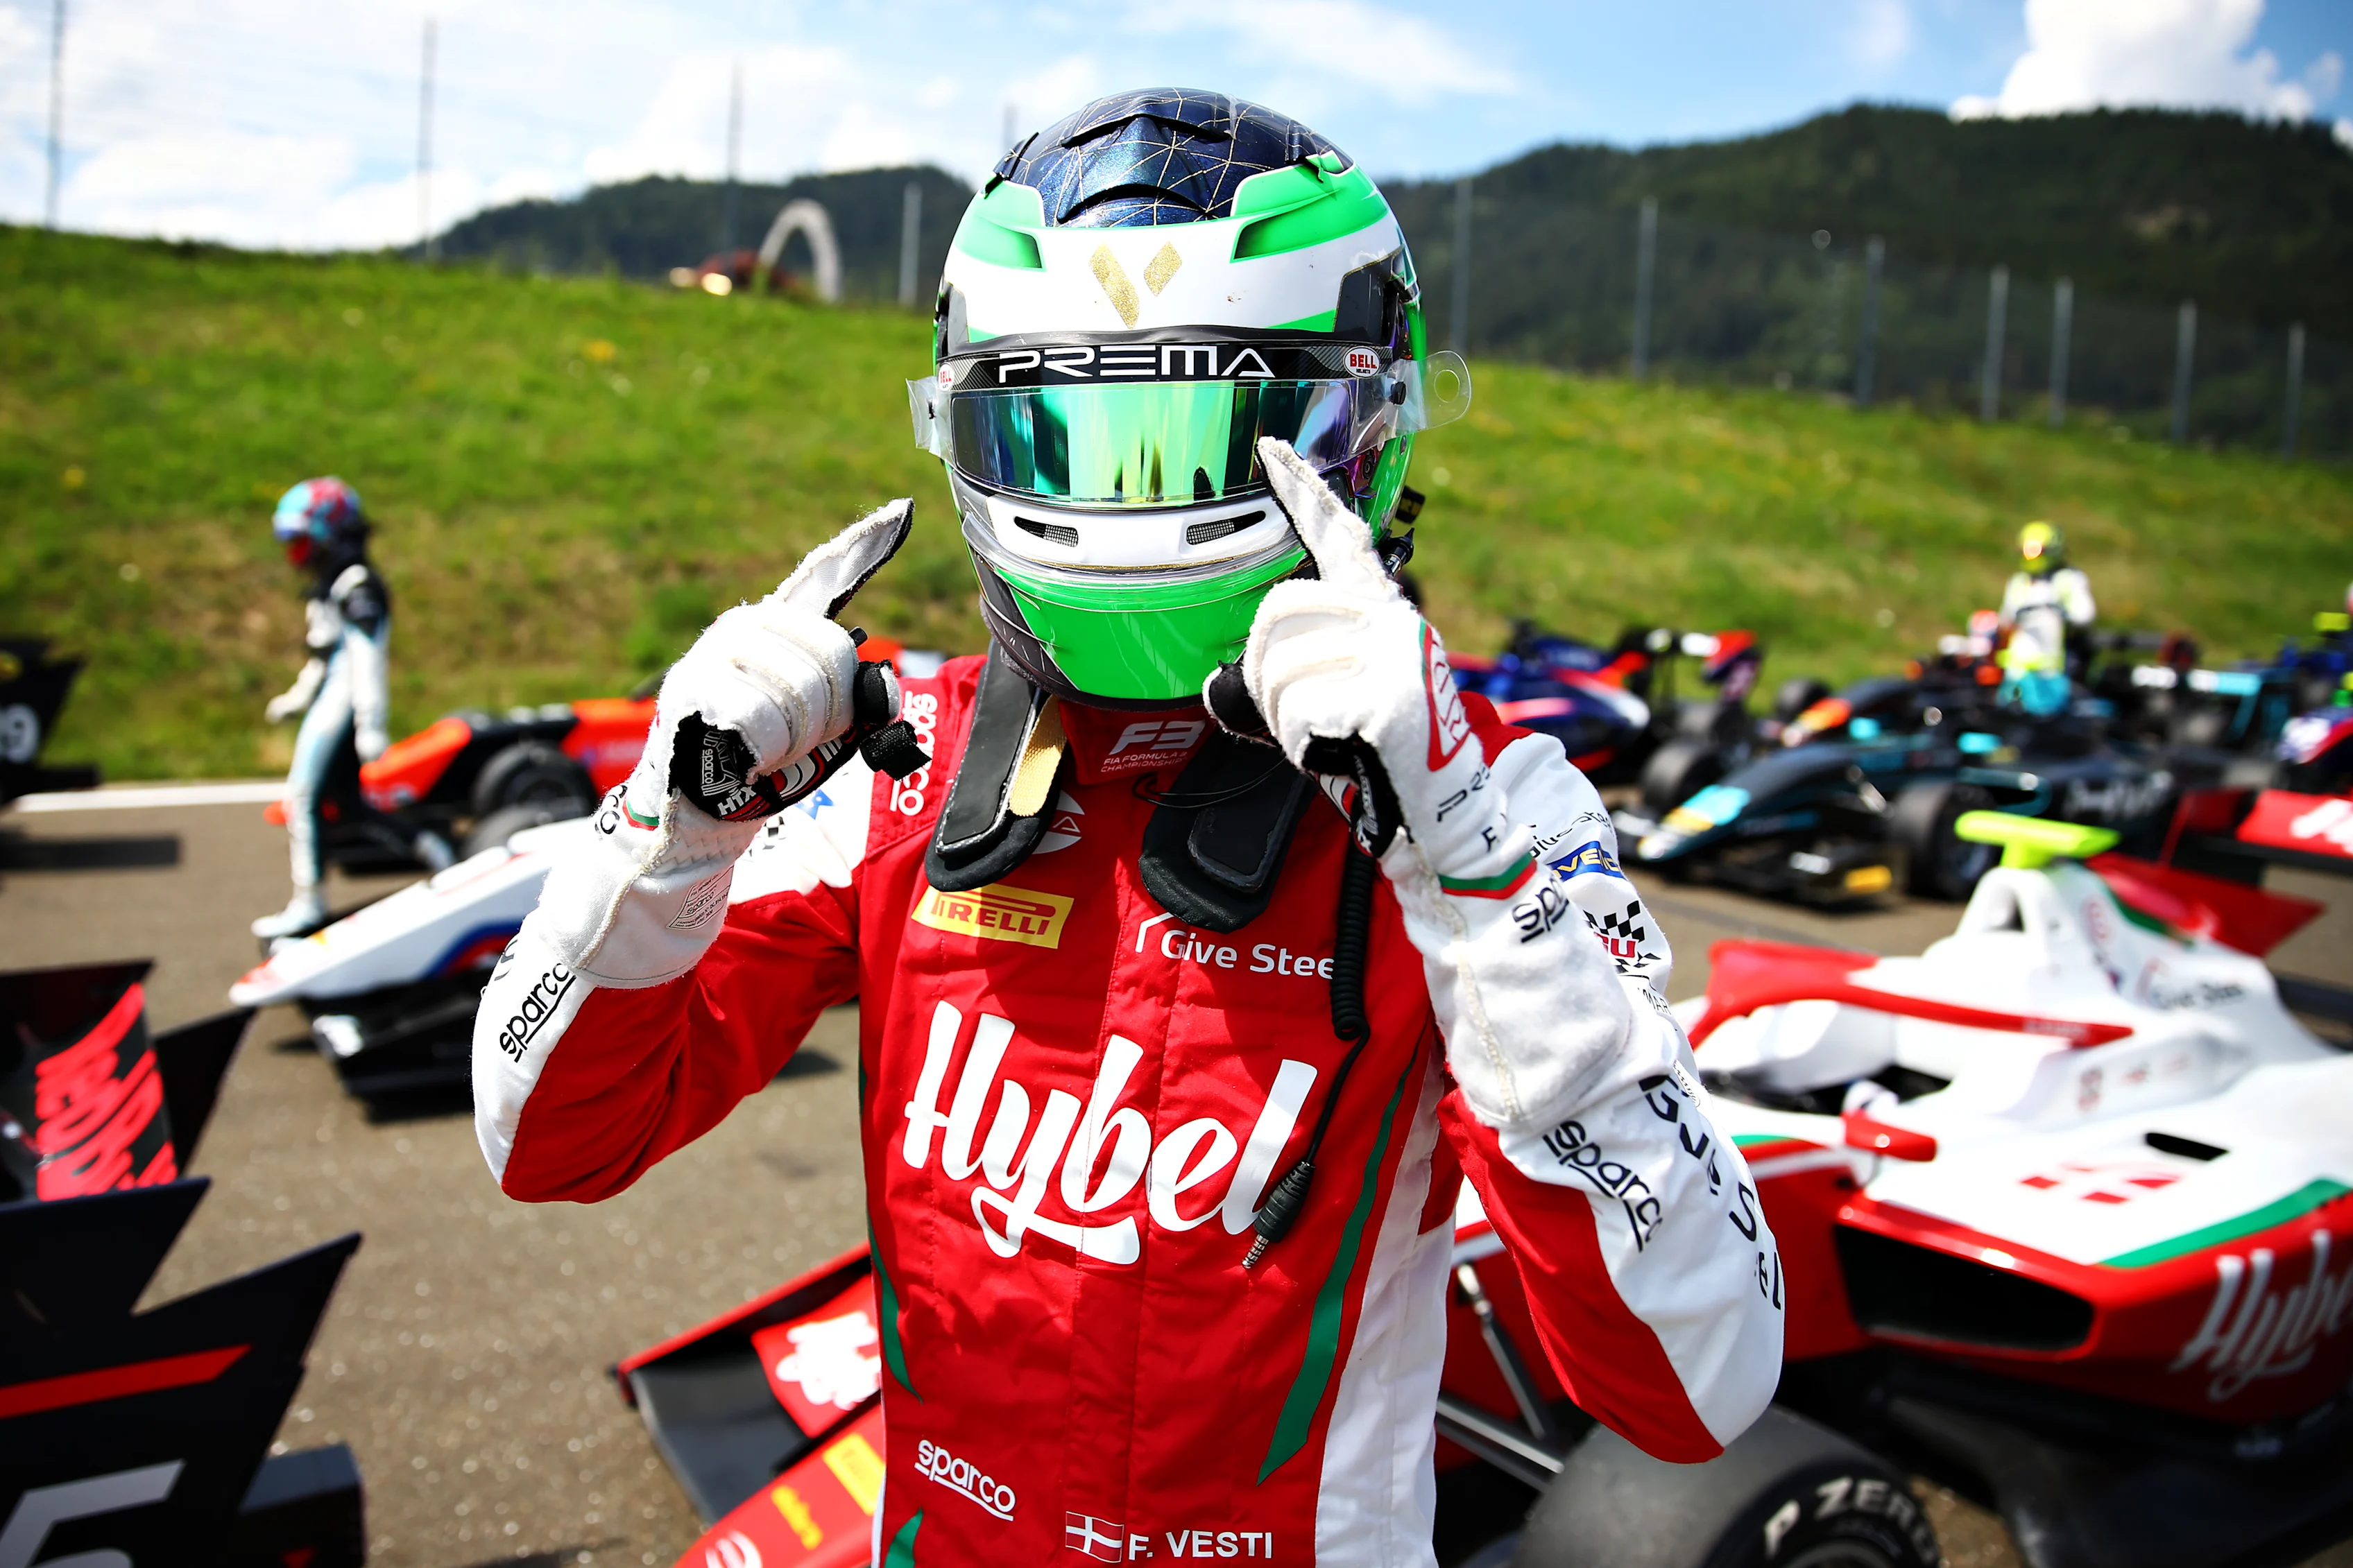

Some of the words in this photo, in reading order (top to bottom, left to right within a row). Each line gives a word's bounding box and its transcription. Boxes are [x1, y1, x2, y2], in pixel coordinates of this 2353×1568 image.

[999, 345, 1276, 383] PREMA
[1349, 353, 1377, 369] BELL
[1109, 719, 1206, 755] F3
[702, 748, 714, 784] sparco
[1100, 758, 1183, 773] CHAMPIONSHIP
[1104, 757, 1120, 765] FIA
[1122, 753, 1178, 763] FORMULA
[1161, 929, 1238, 968] Give
[1249, 943, 1335, 980] Stee
[499, 963, 577, 1063] sparco
[902, 999, 1318, 1266] Hybel
[914, 1439, 1016, 1522] sparco
[1128, 1533, 1154, 1560] F.
[1165, 1530, 1272, 1559] VESTI
